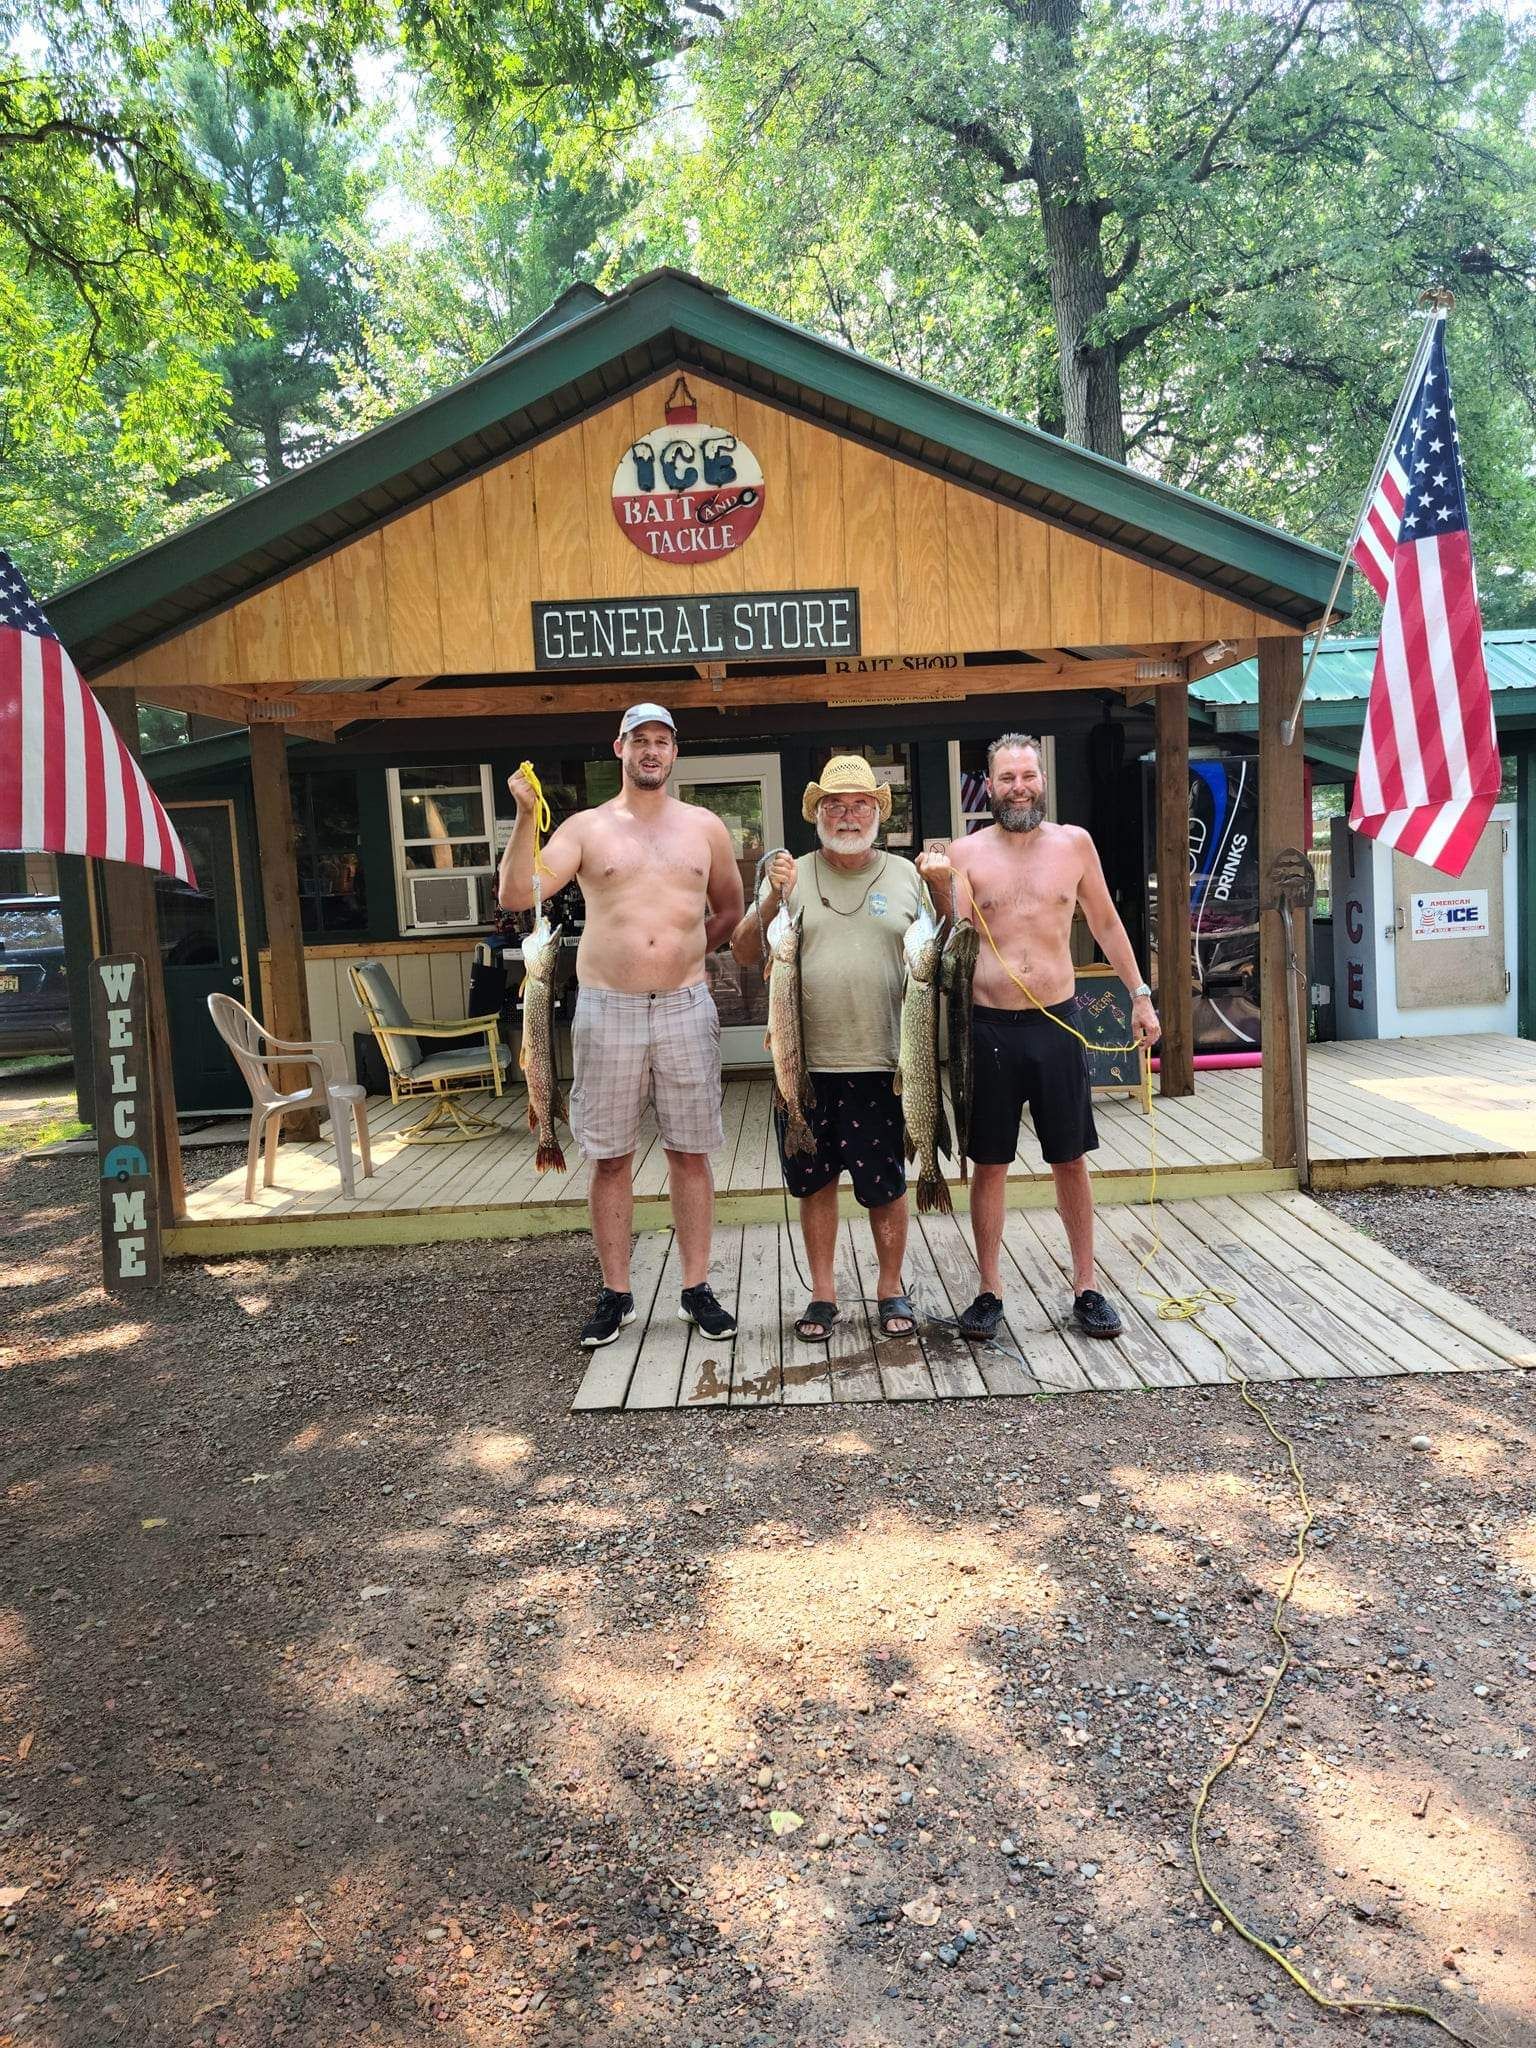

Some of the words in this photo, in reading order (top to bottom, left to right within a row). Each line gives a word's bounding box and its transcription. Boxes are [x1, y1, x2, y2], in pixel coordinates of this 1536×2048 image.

[632, 436, 737, 492] ICE
[622, 496, 696, 524] BAIT
[704, 496, 738, 520] AND
[646, 525, 736, 554] TACKLE
[543, 605, 723, 659] GENERAL
[734, 599, 850, 651] STORE
[1215, 833, 1248, 901] DRINKS
[1430, 898, 1470, 907] AMERICAN
[1447, 907, 1479, 923] ICE
[1075, 991, 1096, 1011] ICE
[1087, 991, 1117, 1019] CREAM
[1085, 1040, 1130, 1063] NDY
